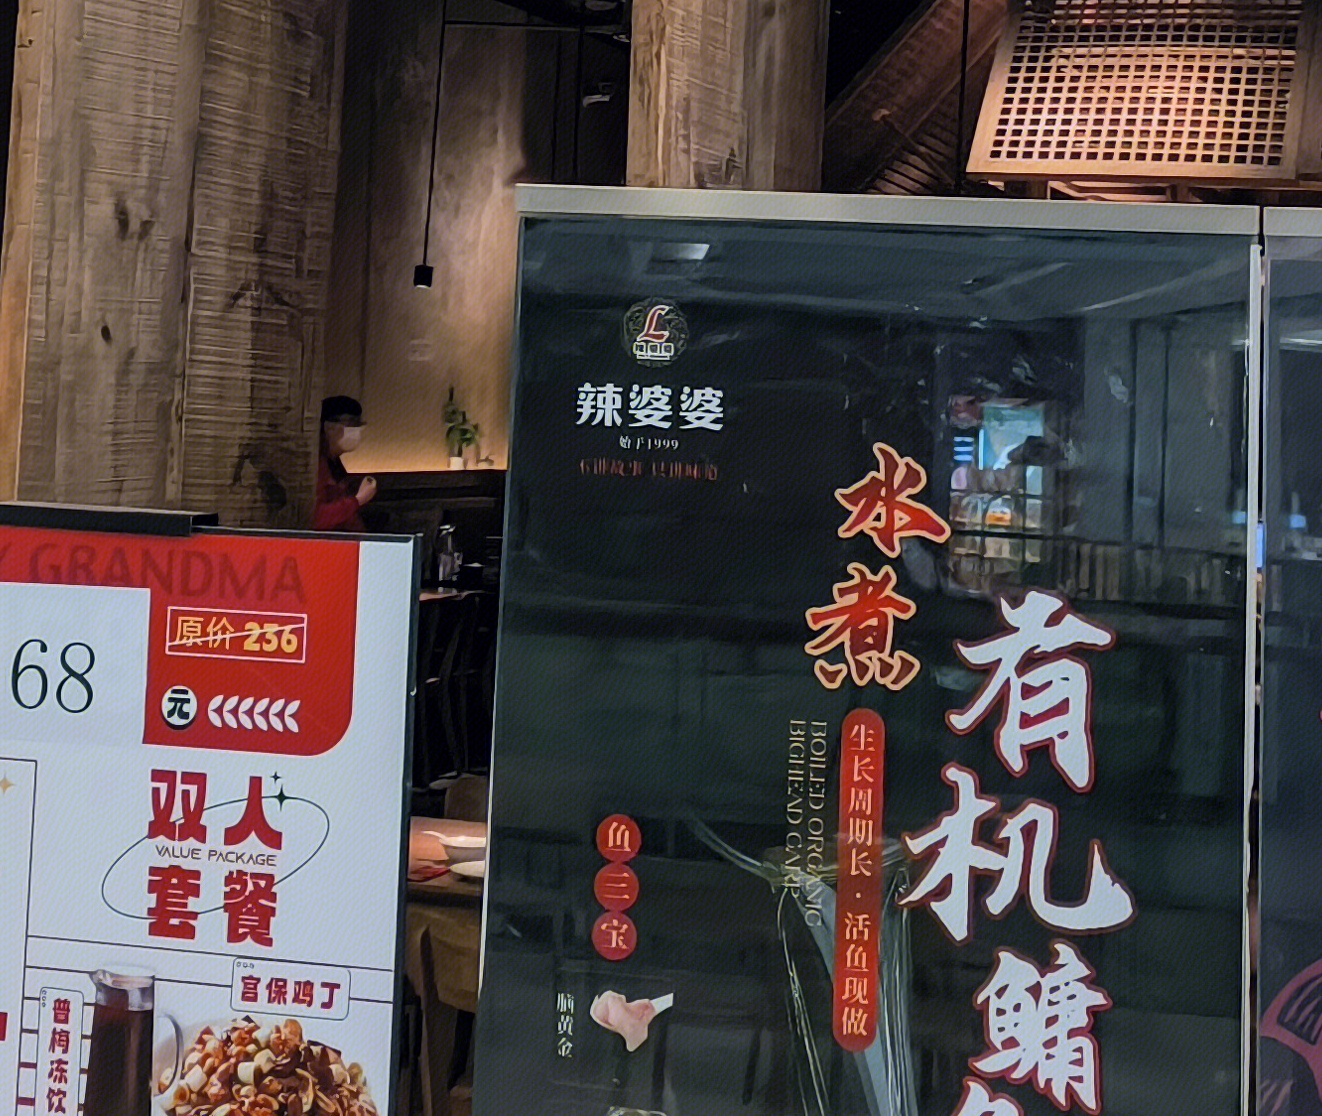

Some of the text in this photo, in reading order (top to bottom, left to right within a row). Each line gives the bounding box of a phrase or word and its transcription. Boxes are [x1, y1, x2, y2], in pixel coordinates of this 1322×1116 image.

[576, 383, 724, 431] 辣婆婆
[807, 443, 949, 690] 水煮
[176, 616, 235, 651] 原价
[165, 688, 192, 720] 元
[787, 719, 807, 825] BIGHEAD
[146, 768, 283, 851] 双人
[804, 721, 827, 928] BOILED ORGANIC
[155, 844, 278, 867] VALUE PACKAGE
[146, 864, 278, 948] 套餐
[240, 974, 341, 1010] 宫保鸡丁
